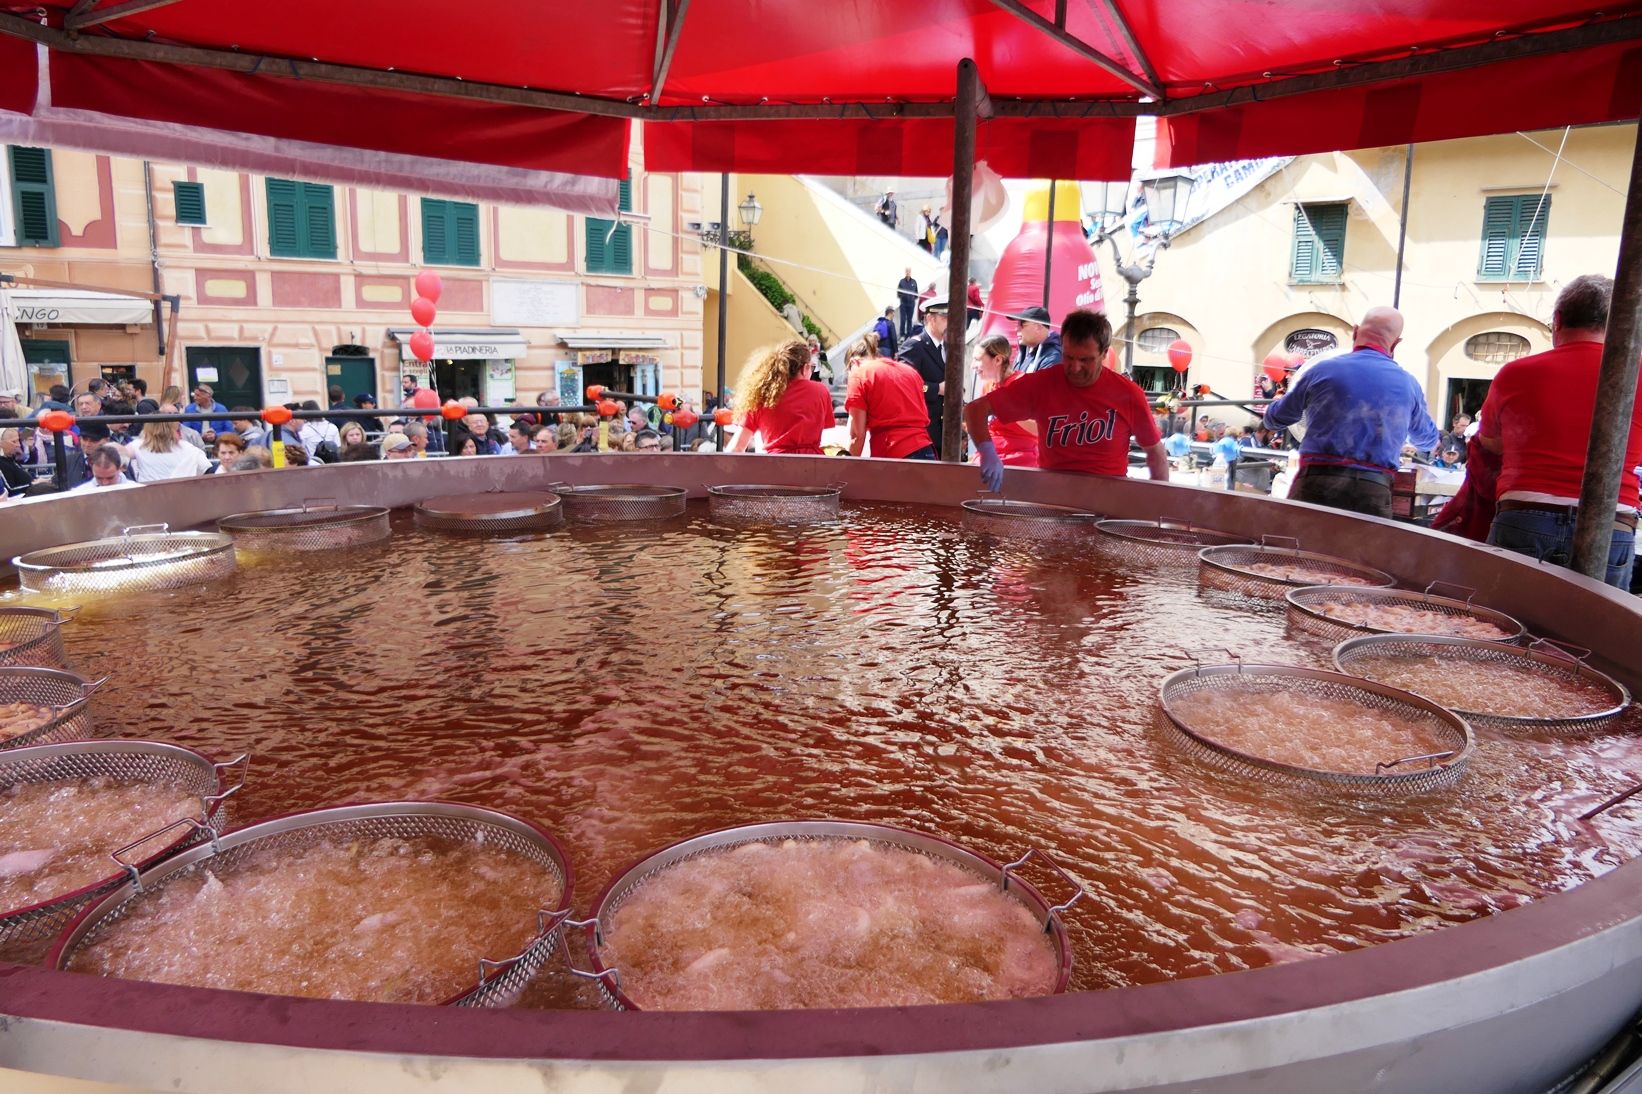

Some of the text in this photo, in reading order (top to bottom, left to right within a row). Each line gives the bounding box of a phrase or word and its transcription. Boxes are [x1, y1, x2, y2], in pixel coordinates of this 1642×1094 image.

[1076, 290, 1094, 306] Olio
[15, 306, 60, 320] NGO
[446, 346, 499, 354] LA PIADINERIA
[1046, 408, 1117, 448] Friol
